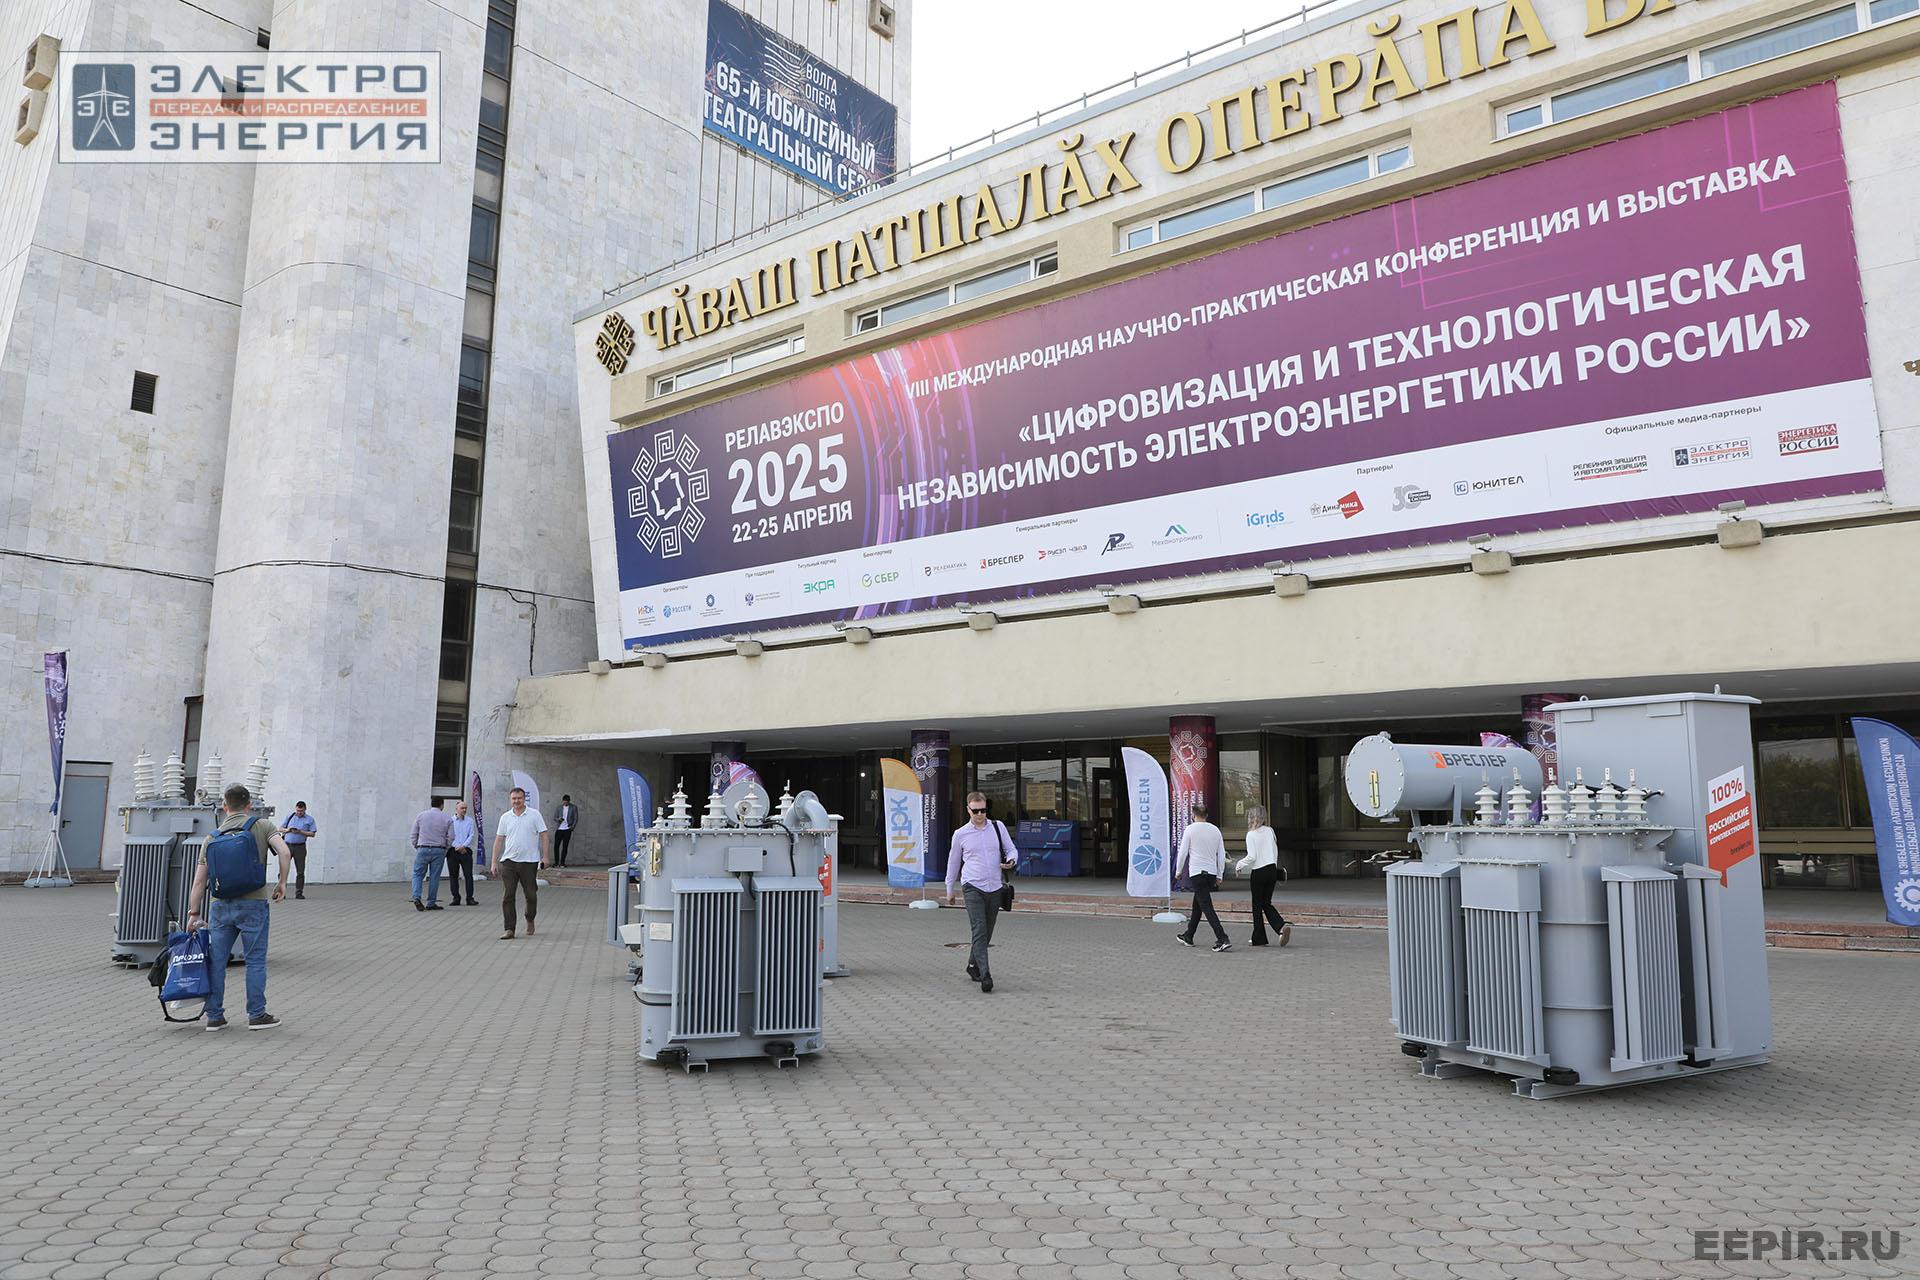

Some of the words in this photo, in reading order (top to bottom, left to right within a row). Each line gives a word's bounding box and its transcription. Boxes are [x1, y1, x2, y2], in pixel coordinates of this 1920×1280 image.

[806, 63, 839, 95] ВОЛГА
[805, 83, 838, 115] ОПЕРА
[704, 90, 834, 184] ТЕАТРАЛЬНЫЙ
[837, 163, 881, 197] СЕЗ
[765, 87, 876, 174] ЮБИЛЕЙНЫЙ
[641, 257, 799, 351] ЧĂВАШ
[808, 132, 1142, 297] ПАТШАЛĂХ
[905, 379, 931, 400] VIII
[933, 335, 1094, 393] МЕЖДУНАРОДНАЯ
[1097, 262, 1369, 351] НАУЧНО-ПРАКТИЧЕСКАЯ
[1375, 206, 1580, 280] КОНФЕРЕНЦИЯ
[1588, 199, 1610, 225] И
[1616, 153, 1796, 219] ВЫСТАВКА
[1018, 354, 1304, 444] «ЦИФРОВИЗАЦИЯ
[1312, 345, 1341, 381] И
[1348, 243, 1806, 372] ТЕХНОЛОГИЧЕСКАЯ
[897, 442, 1139, 511] НЕЗАВИСИМОСТЬ
[1145, 351, 1563, 464] ЭЛЕКТРОЭНЕРГЕТИКИ
[1575, 308, 1811, 381] РОССИИ»
[1604, 418, 1675, 435] Официальные
[1677, 405, 1762, 425] медиа-партнеры
[725, 401, 844, 453] РЕЛАВЭКСПО
[1690, 439, 1749, 453] ЭЛЕКТРО
[1691, 450, 1750, 465] ЭНЕРГИЯ
[1779, 435, 1839, 453] РОССИИ
[728, 433, 848, 515] 2025
[1356, 464, 1394, 476] Партнеры
[1472, 475, 1525, 491] ЮНИТЕЛ
[732, 515, 779, 544] 22-25
[782, 500, 853, 534] АПРЕЛЯ
[987, 554, 1025, 567] БРЕСЛЕР
[874, 571, 900, 584] СБЕР
[1444, 753, 1507, 767] БРЕСЛЕР
[1711, 777, 1743, 804] 100%
[1708, 806, 1750, 835] РОССИЙСКИЕ
